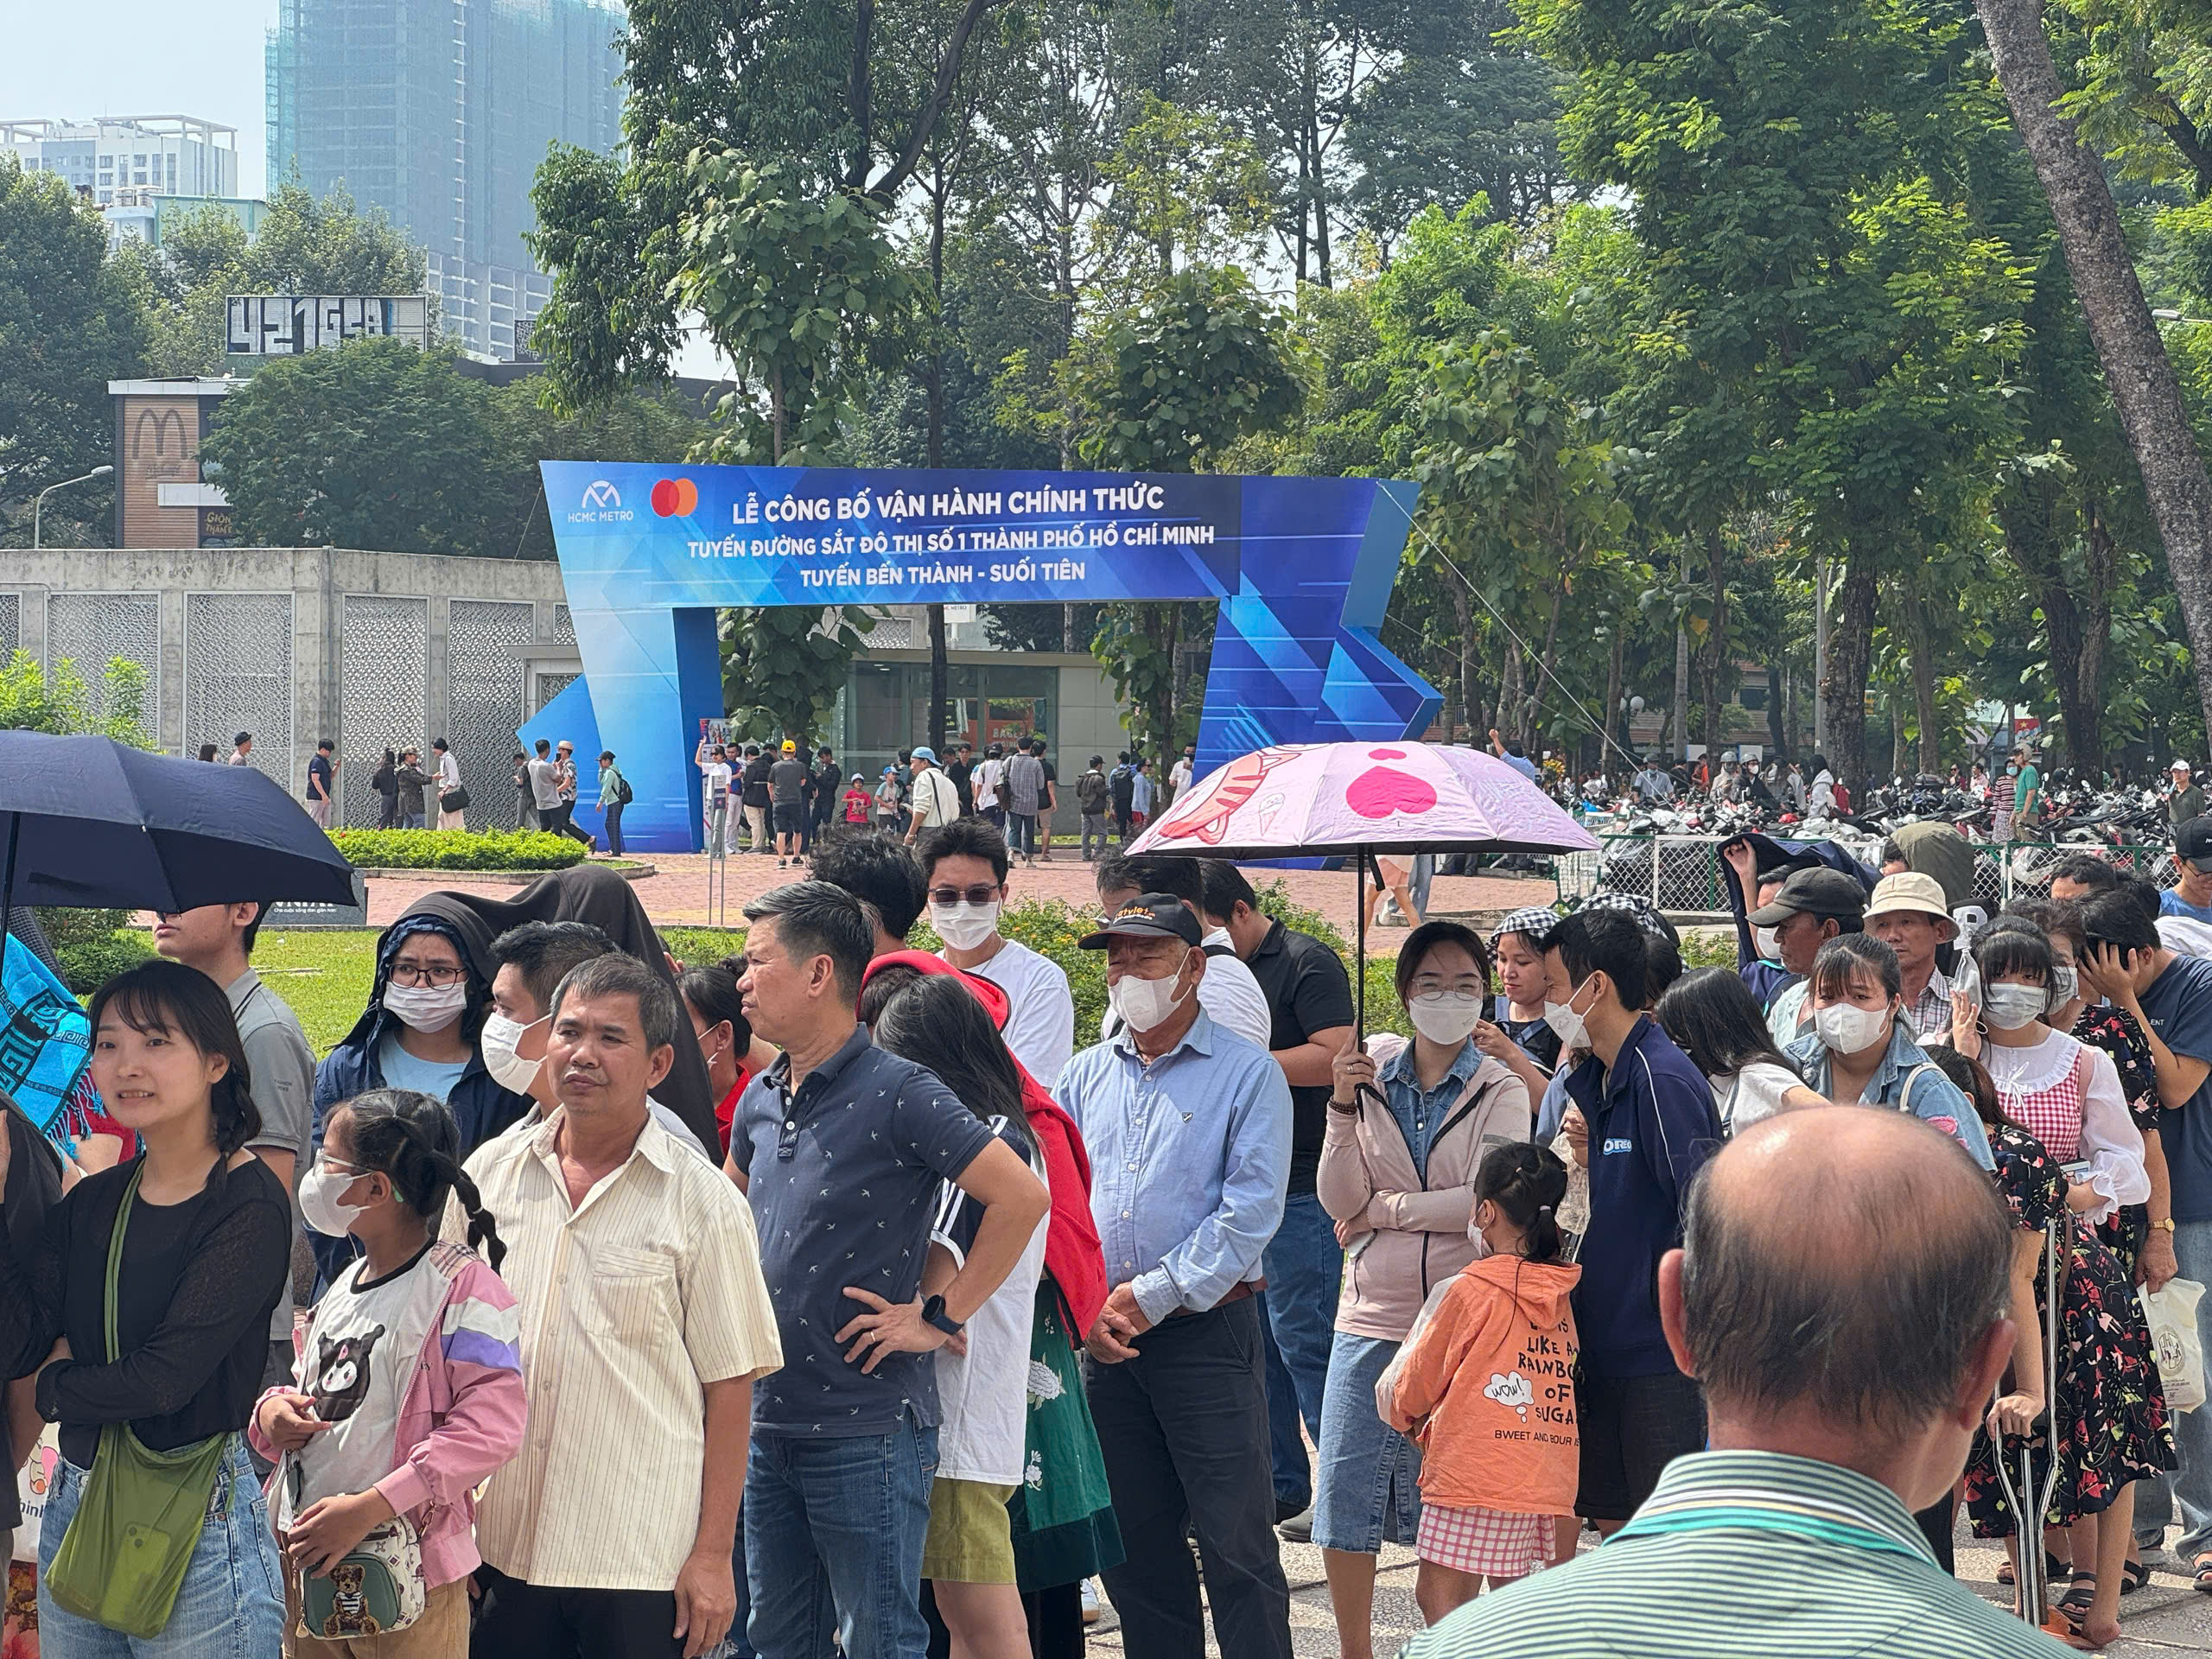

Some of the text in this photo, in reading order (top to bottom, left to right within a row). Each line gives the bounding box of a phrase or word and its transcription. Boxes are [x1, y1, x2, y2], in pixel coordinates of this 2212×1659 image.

[733, 480, 1165, 524] LỄ CÔNG BỐ VẬN HÀNH CHÍNH THỨC
[568, 510, 633, 523] HCMC METRO
[687, 520, 1214, 558] TUYẾN ĐƯỜNG SẮT ĐÔ THỊ SỐ 1 THÀNH PHỐ HỒ CHÍ MINH
[800, 562, 861, 587] TUYẾN
[866, 561, 902, 585] BẾN
[907, 561, 973, 584] THÀNH
[989, 556, 1036, 582] SUỐI
[1040, 558, 1085, 581] TIÊN
[1527, 1335, 1573, 1357] LIKE A
[1535, 1406, 1578, 1425] SUGA
[1534, 1432, 1548, 1442] AND
